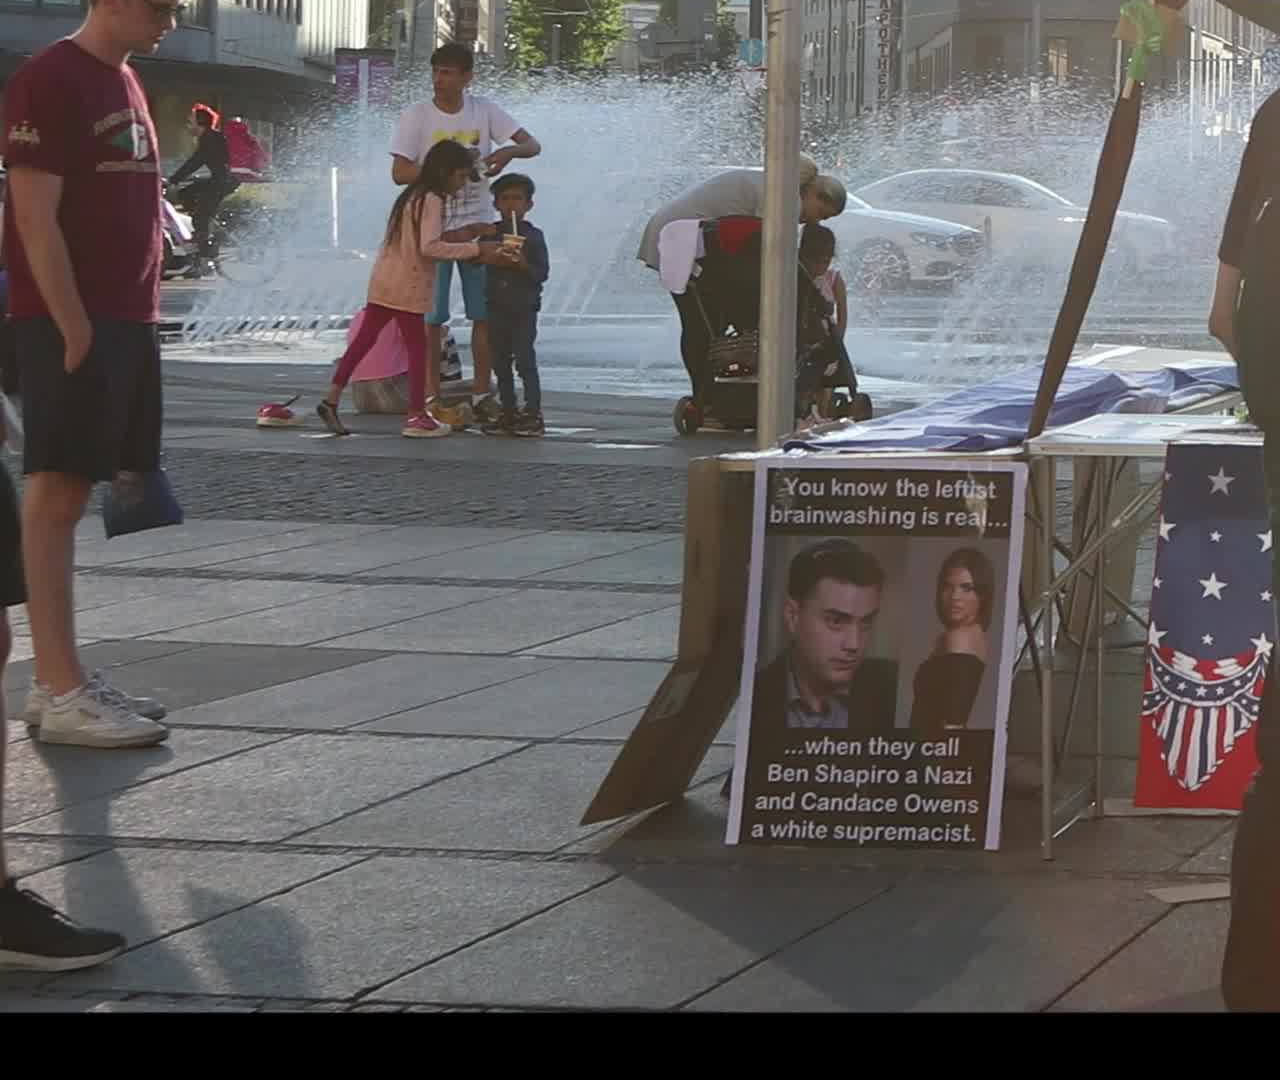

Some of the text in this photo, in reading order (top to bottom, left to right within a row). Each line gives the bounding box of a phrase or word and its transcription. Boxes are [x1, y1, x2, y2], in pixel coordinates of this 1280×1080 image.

[784, 477, 998, 500] You know the leftist
[769, 505, 916, 529] brainwashing
[922, 507, 940, 526] is
[868, 736, 915, 760] they
[921, 737, 960, 757] call
[767, 763, 973, 788] Ben Shapiro a Nazi
[755, 792, 979, 815] and Candace Owens
[751, 820, 977, 845] a white supremacist.
